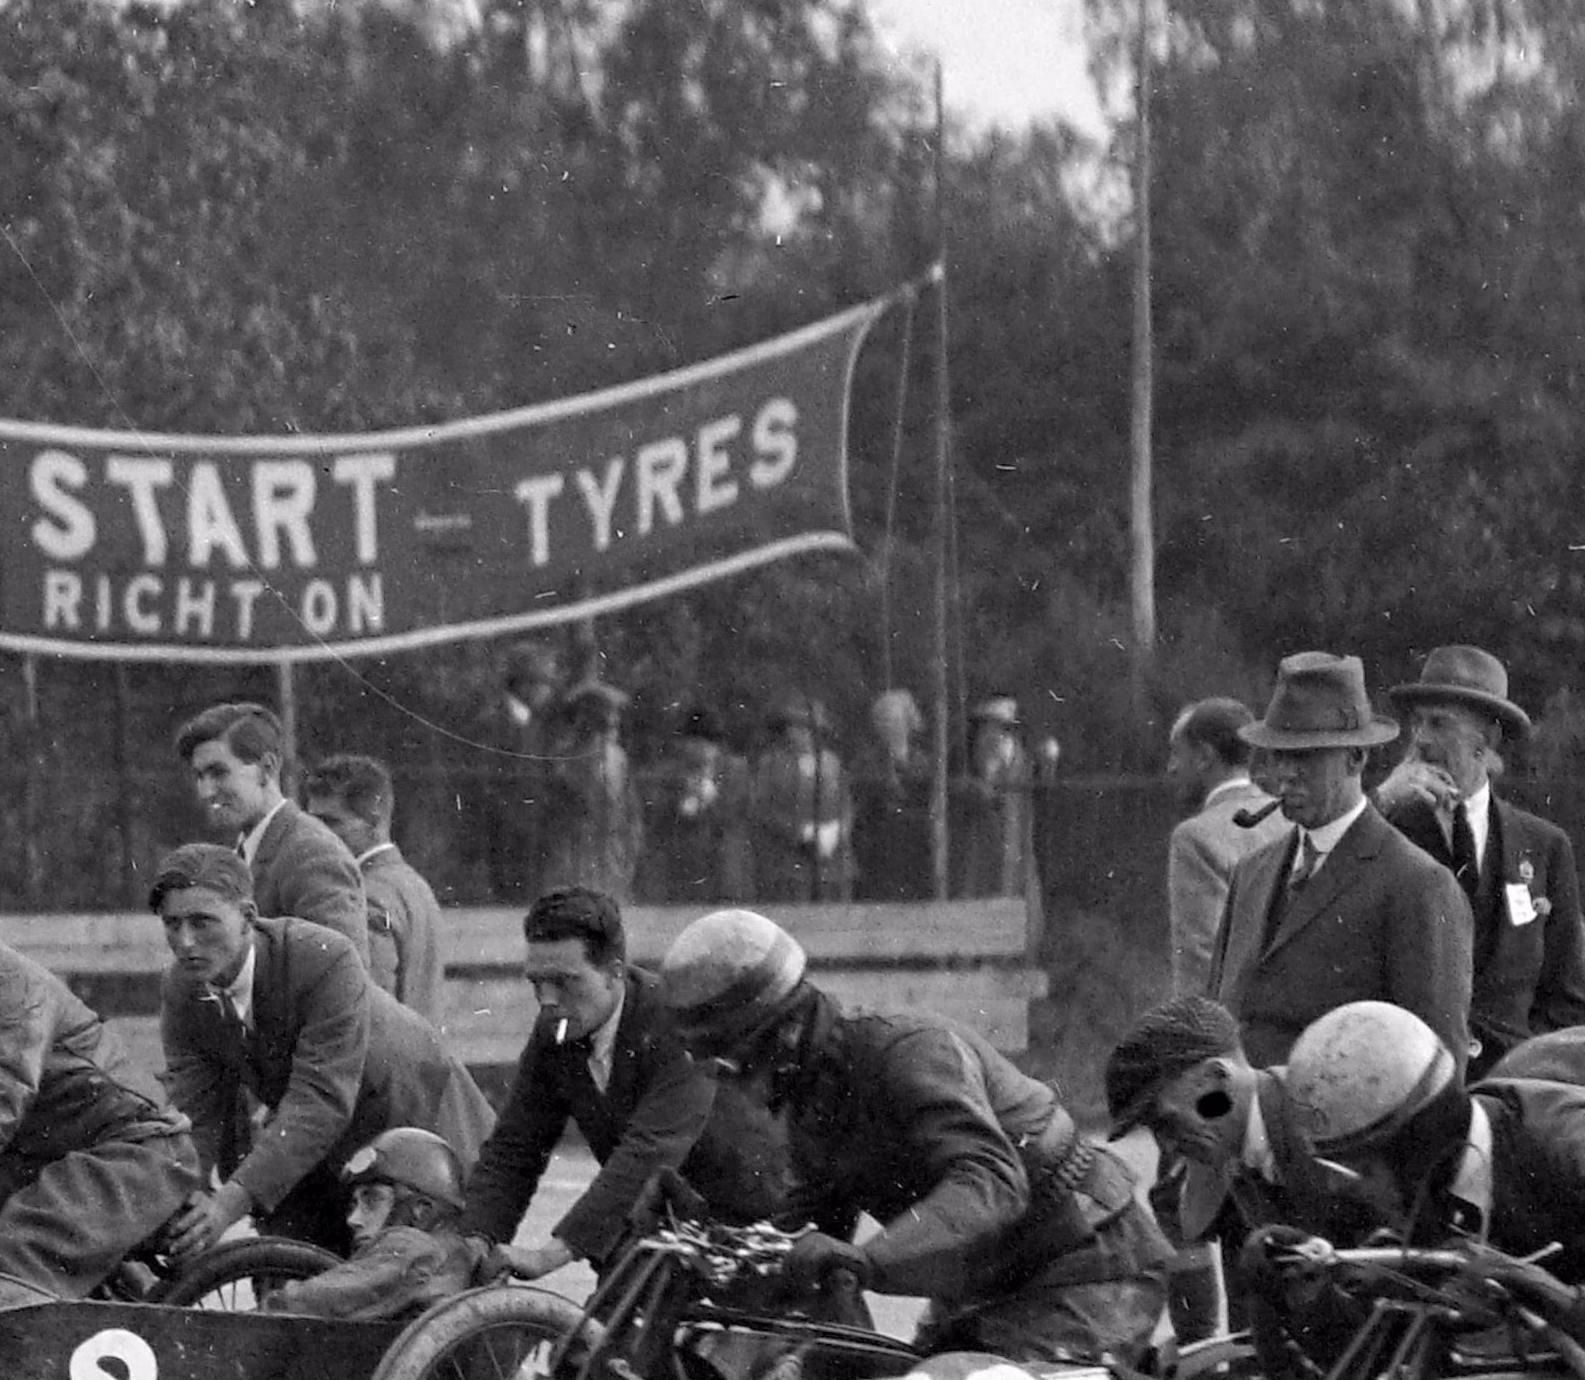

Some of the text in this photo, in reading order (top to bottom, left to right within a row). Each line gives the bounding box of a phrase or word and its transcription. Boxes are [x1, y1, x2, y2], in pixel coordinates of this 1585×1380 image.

[29, 450, 397, 570] START
[513, 397, 800, 567] TYRES
[301, 573, 385, 636] ON
